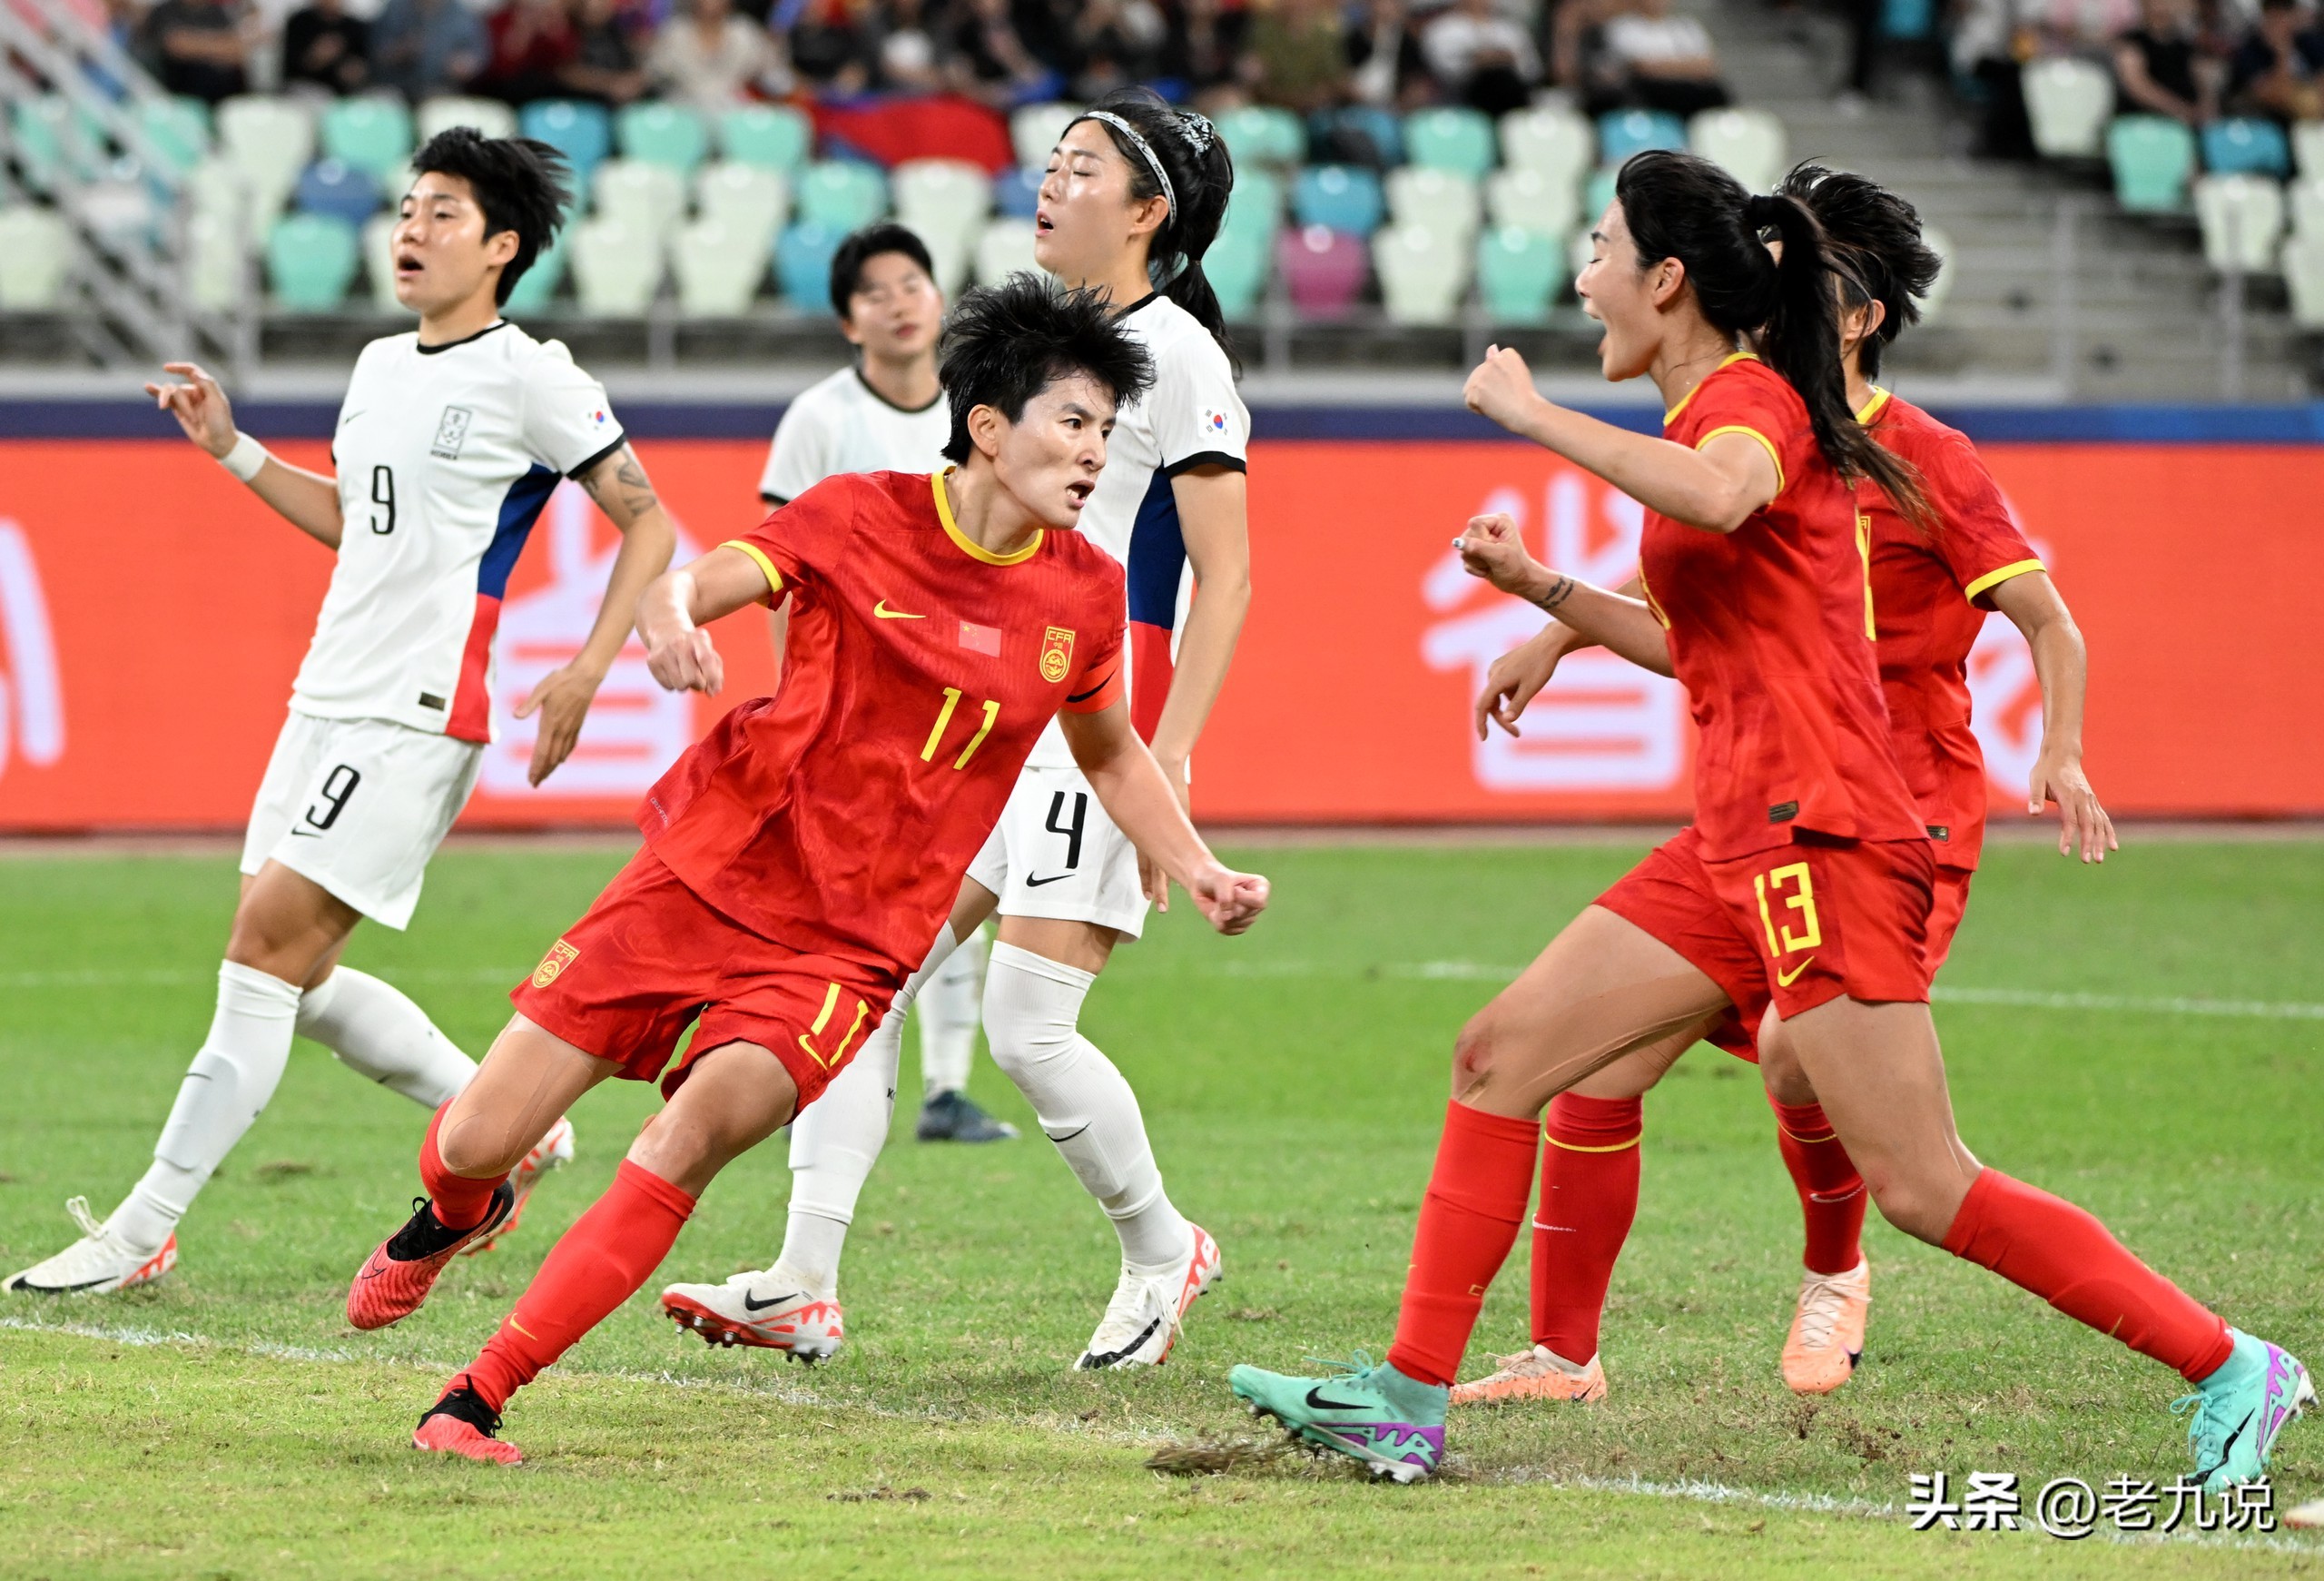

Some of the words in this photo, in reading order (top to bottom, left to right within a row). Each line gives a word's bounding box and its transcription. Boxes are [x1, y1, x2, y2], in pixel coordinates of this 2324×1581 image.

[370, 464, 395, 535] 9
[1047, 629, 1072, 644] CFA
[1421, 470, 1687, 790] 省
[920, 687, 1000, 770] 11
[305, 764, 360, 830] 9
[1045, 791, 1088, 869] 4
[1754, 862, 1821, 958] 13
[554, 943, 576, 961] CFA
[810, 982, 869, 1067] 11
